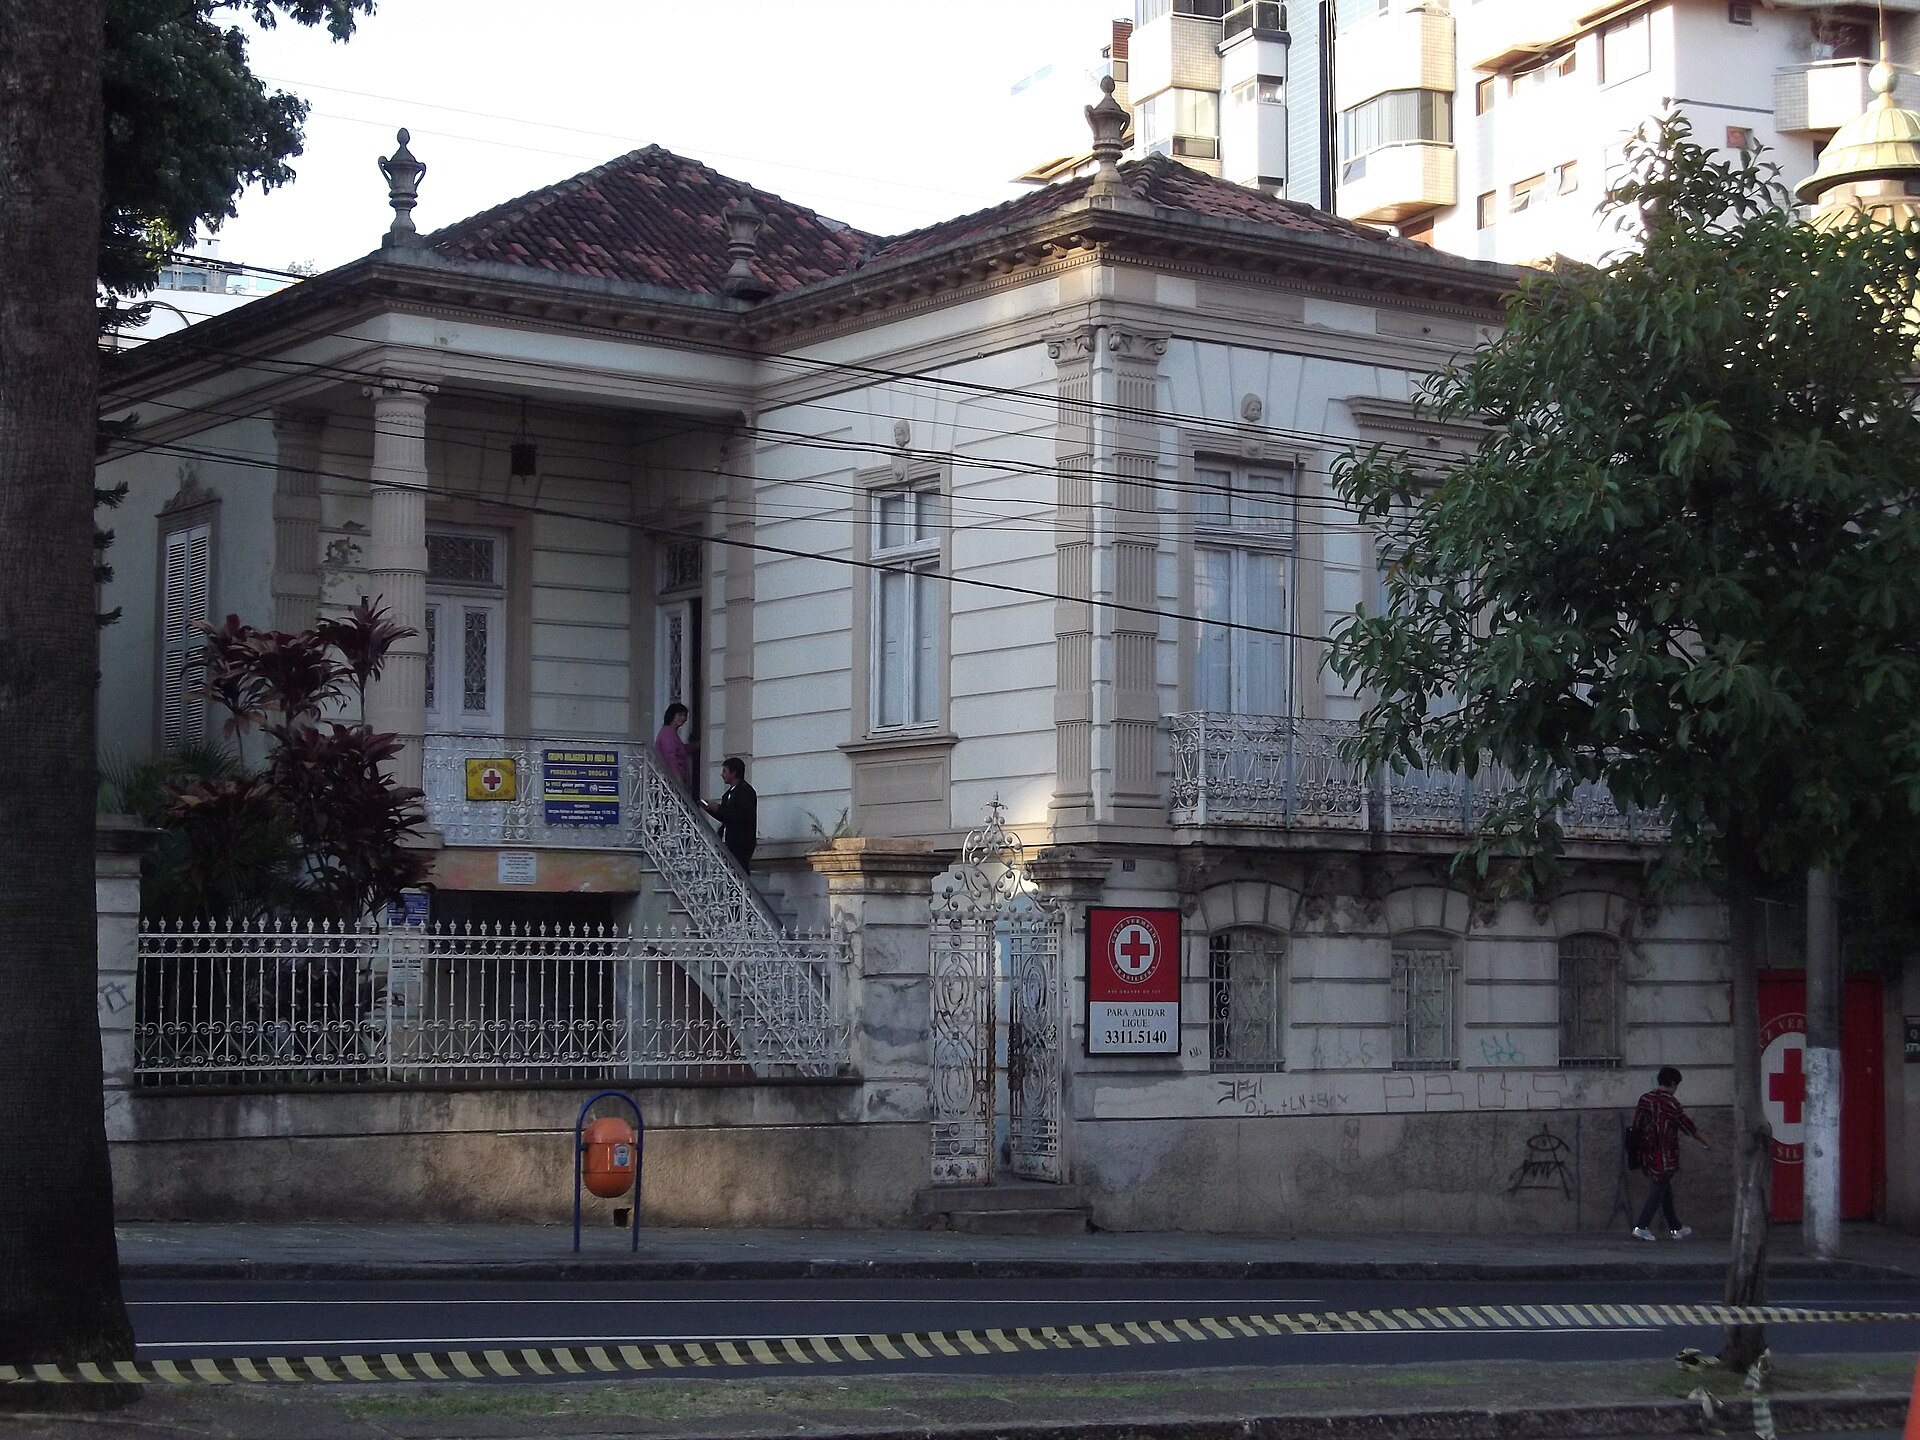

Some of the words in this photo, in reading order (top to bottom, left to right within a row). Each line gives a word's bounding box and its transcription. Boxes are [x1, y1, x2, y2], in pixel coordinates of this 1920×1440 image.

[1107, 1008, 1129, 1017] PARA
[1132, 1008, 1166, 1018] AJUDAR
[1122, 1019, 1151, 1028] LIGUE:
[1105, 1029, 1167, 1045] 3311.5140
